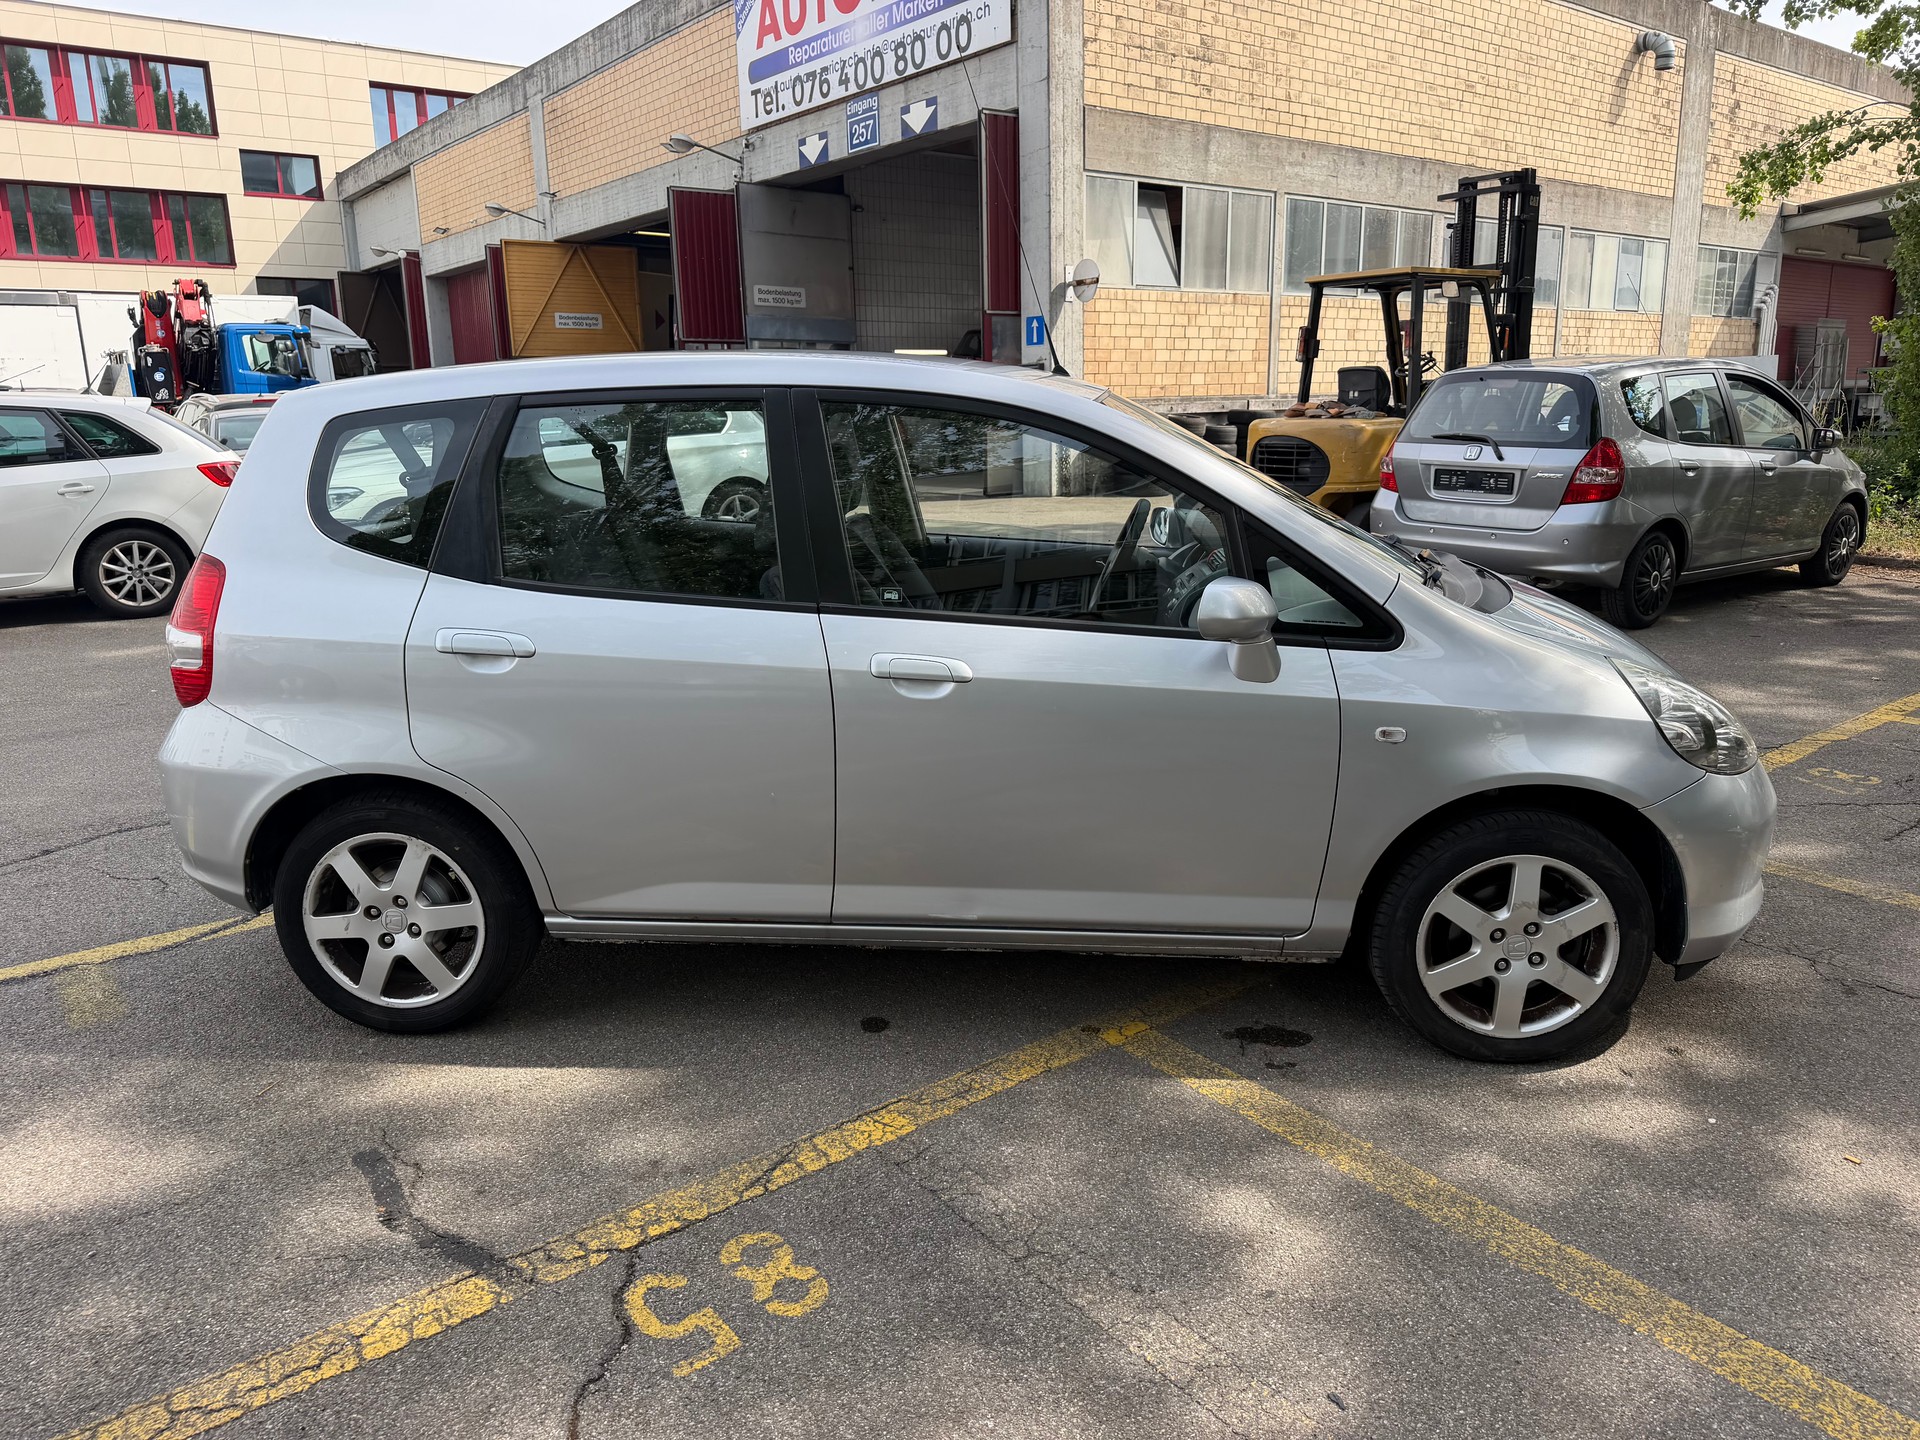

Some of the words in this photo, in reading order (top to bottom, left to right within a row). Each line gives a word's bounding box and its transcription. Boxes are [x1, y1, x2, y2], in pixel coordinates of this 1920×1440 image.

[756, 0, 861, 50] AU
[892, 0, 944, 25] Marken
[750, 80, 787, 119] Tel.
[792, 66, 832, 107] 076
[838, 50, 885, 93] 400
[894, 33, 927, 77] 80
[935, 13, 973, 61] 00
[846, 96, 878, 115] Eingang
[852, 119, 874, 145] 257
[757, 287, 802, 298] Bodenbelastung
[558, 314, 599, 322] Bodenbelastung
